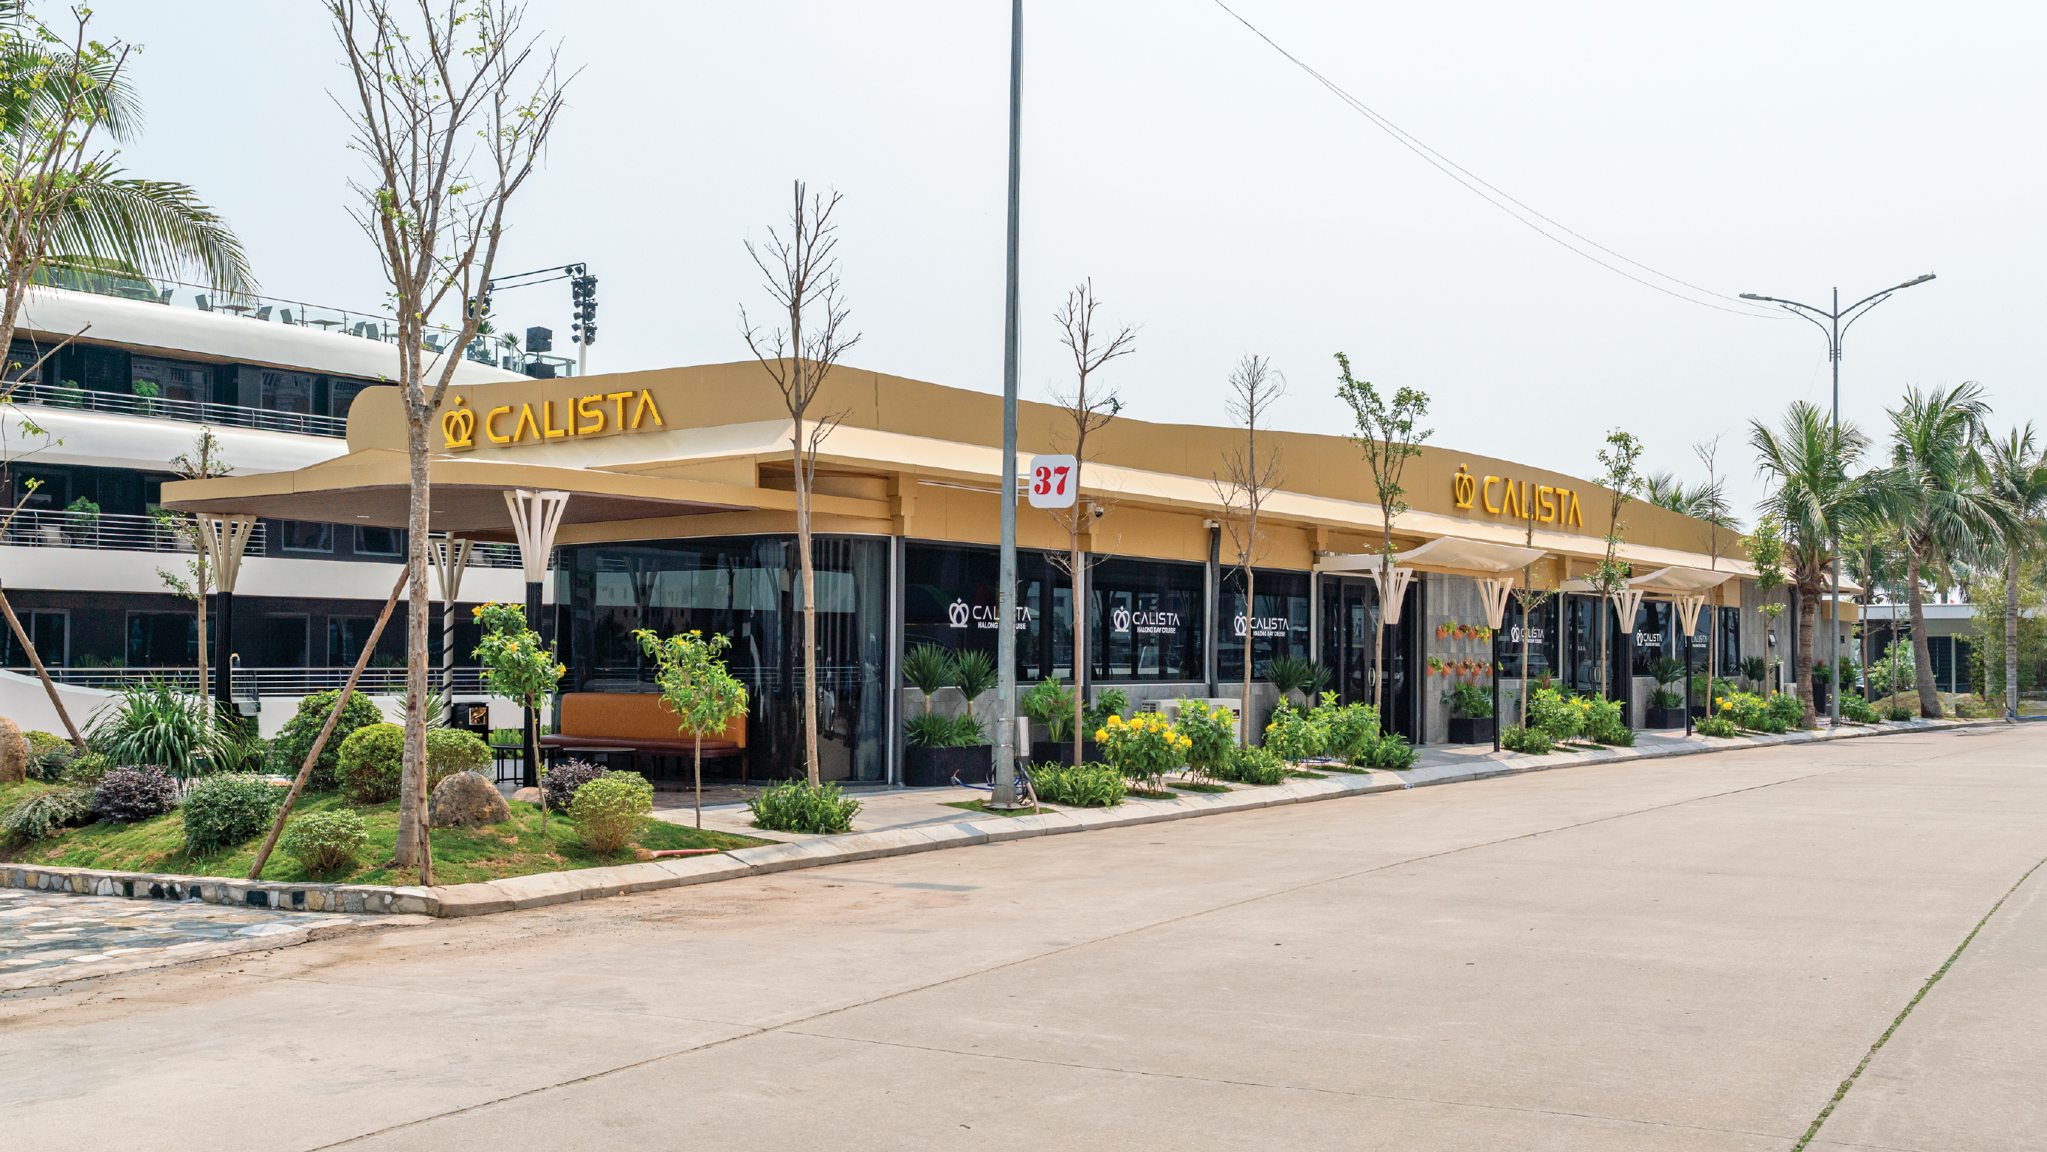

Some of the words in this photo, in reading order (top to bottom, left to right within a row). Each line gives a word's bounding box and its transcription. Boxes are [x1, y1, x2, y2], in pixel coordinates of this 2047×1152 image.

[485, 389, 665, 443] CALISTA
[1034, 466, 1070, 495] 37
[1481, 475, 1583, 527] CALISTA
[973, 605, 1031, 621] CALTA
[1132, 612, 1180, 626] CALISTA
[977, 621, 998, 629] HALONG
[1250, 617, 1289, 630] CALISTA
[1520, 628, 1545, 639] CLISTA
